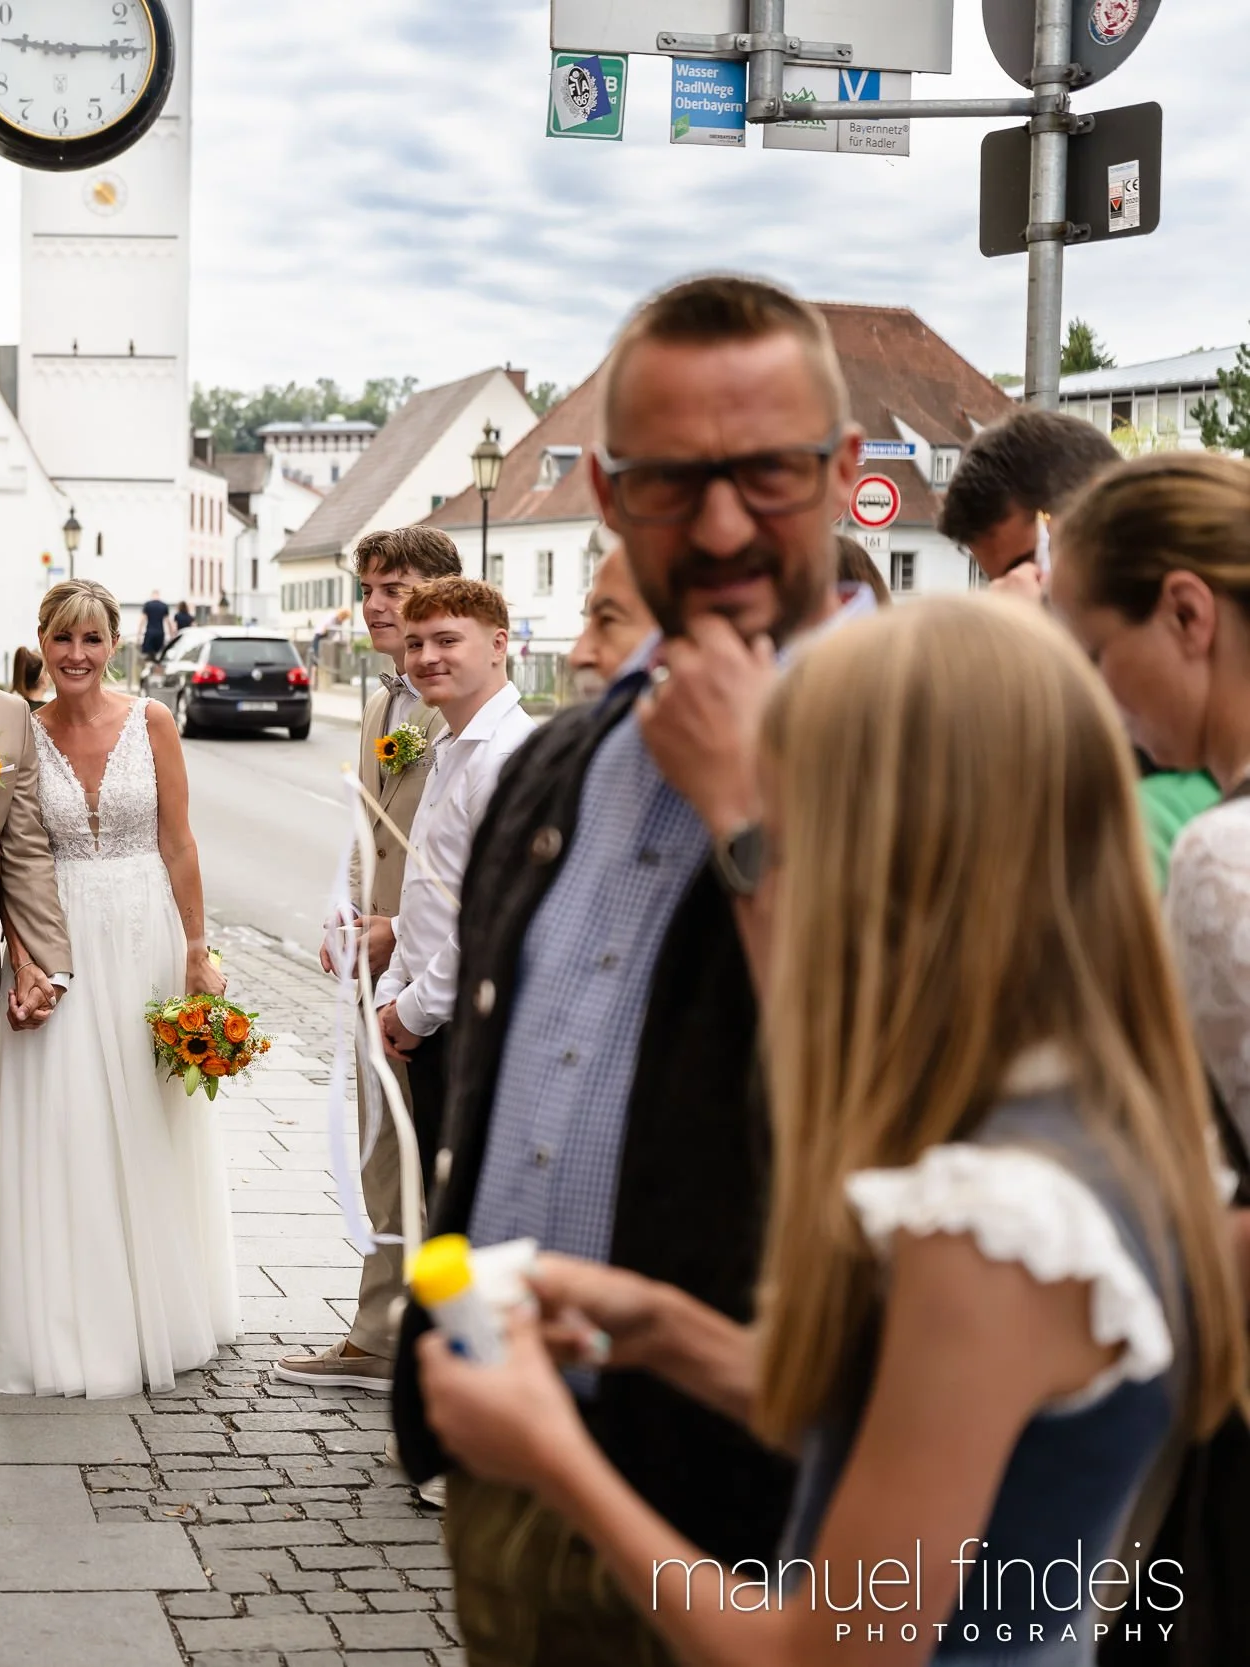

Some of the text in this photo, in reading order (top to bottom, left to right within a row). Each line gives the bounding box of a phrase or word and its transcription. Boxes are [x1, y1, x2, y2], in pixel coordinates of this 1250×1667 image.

[112, 3, 128, 25] 2
[675, 63, 719, 78] Wasser
[111, 73, 126, 95] 4
[675, 80, 734, 99] RadlWege
[19, 98, 34, 120] 7
[88, 98, 102, 120] 5
[675, 97, 743, 115] Oberbayern
[53, 106, 69, 129] 6
[849, 135, 897, 149] für Radler
